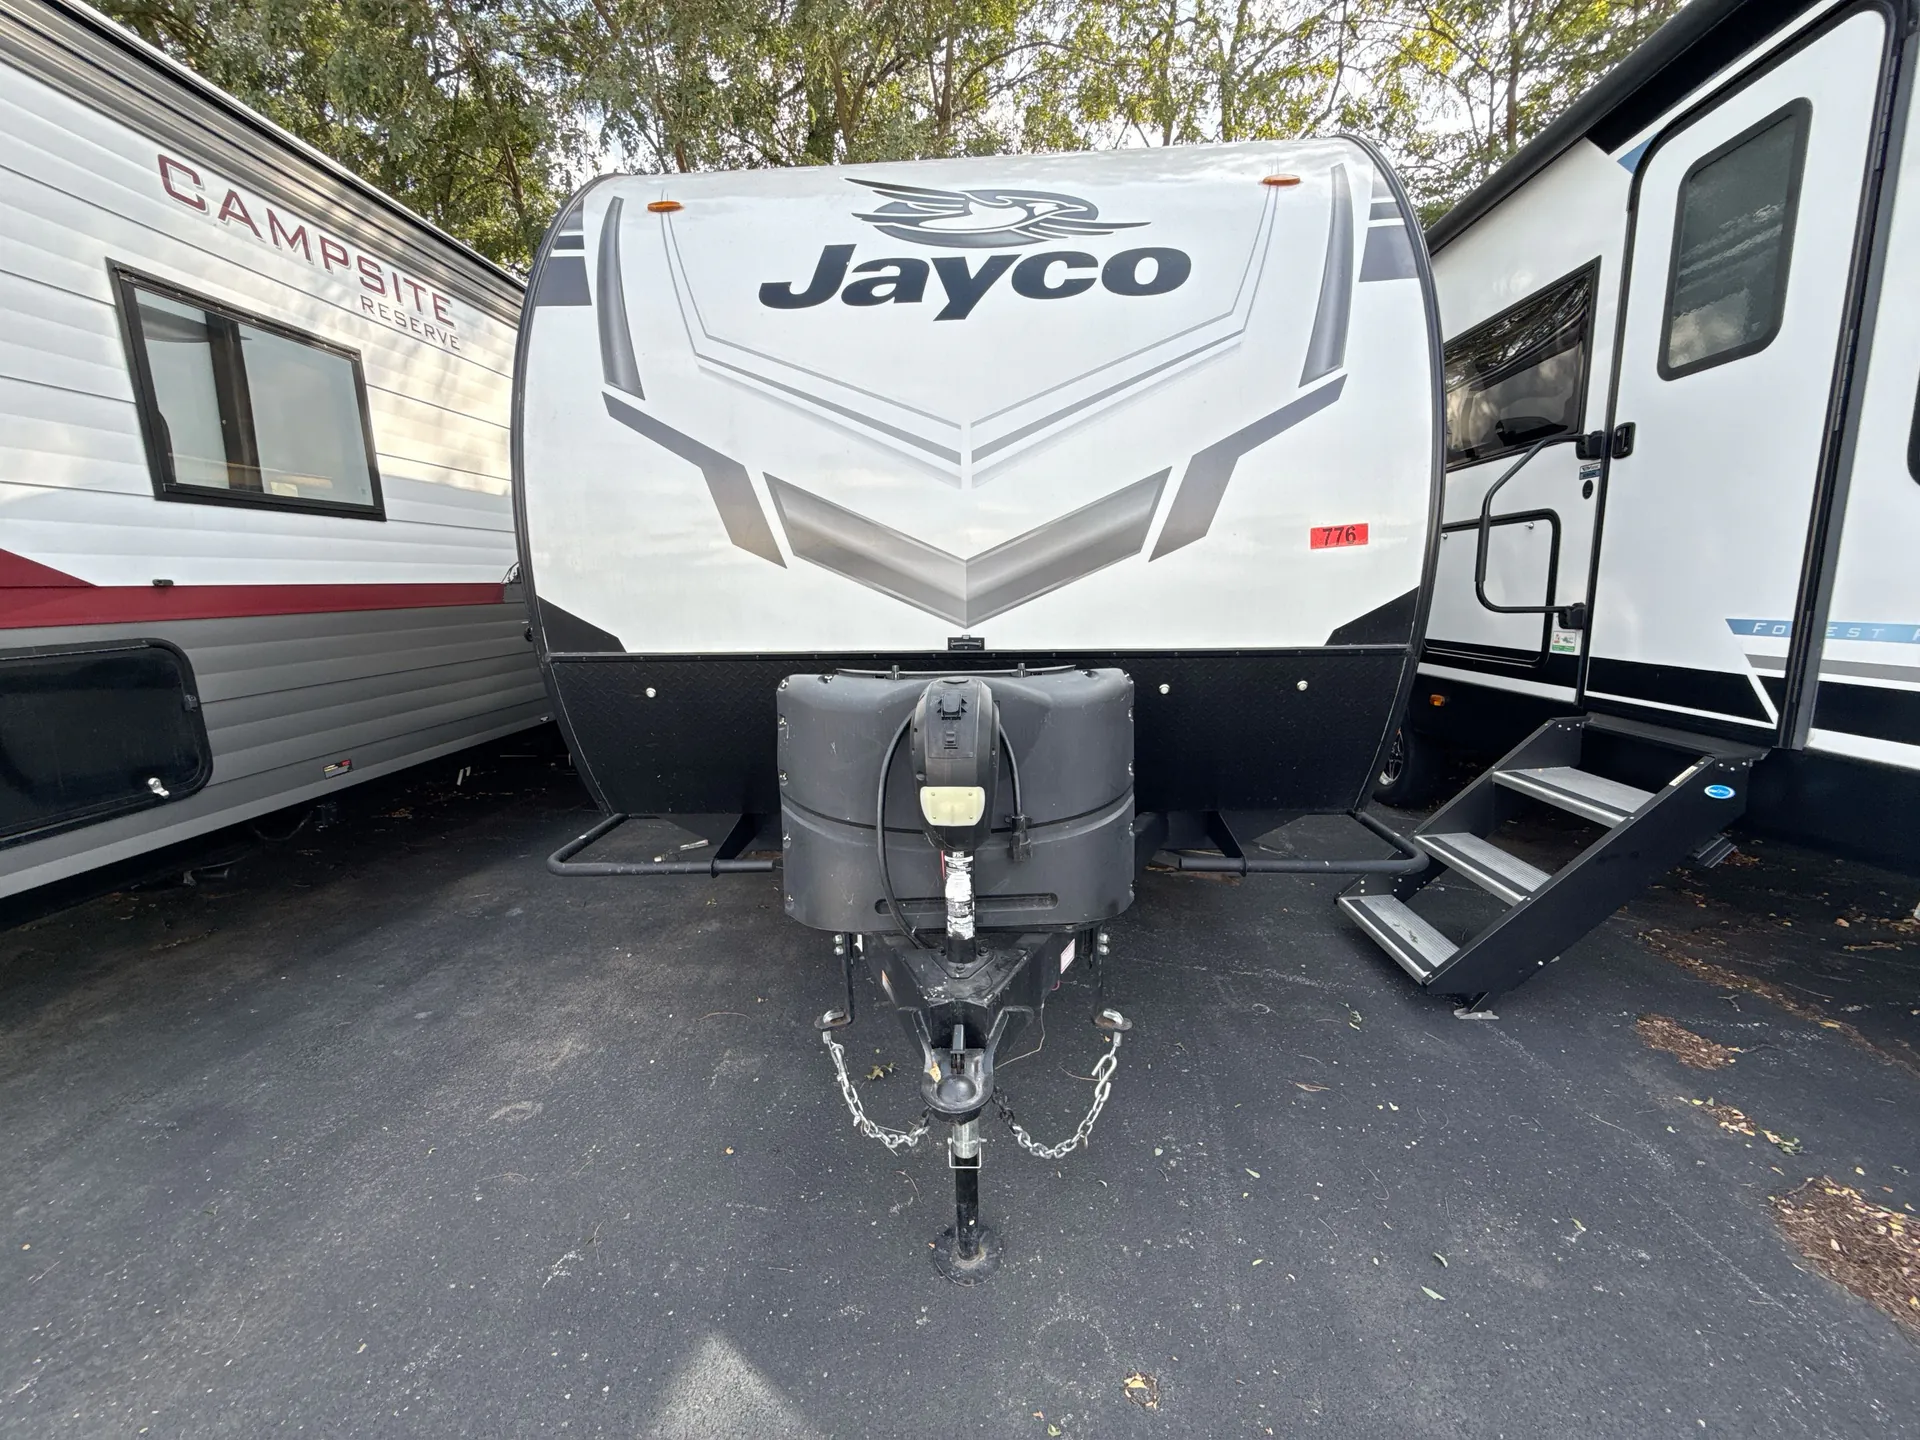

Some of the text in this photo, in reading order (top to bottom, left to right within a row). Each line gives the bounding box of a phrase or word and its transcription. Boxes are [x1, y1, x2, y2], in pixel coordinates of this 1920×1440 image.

[157, 154, 456, 329] CAMPSITE
[758, 243, 1192, 321] Jayco
[360, 295, 460, 351] RESERVE
[1322, 525, 1356, 546] 776
[1752, 622, 1885, 639] FOEST
